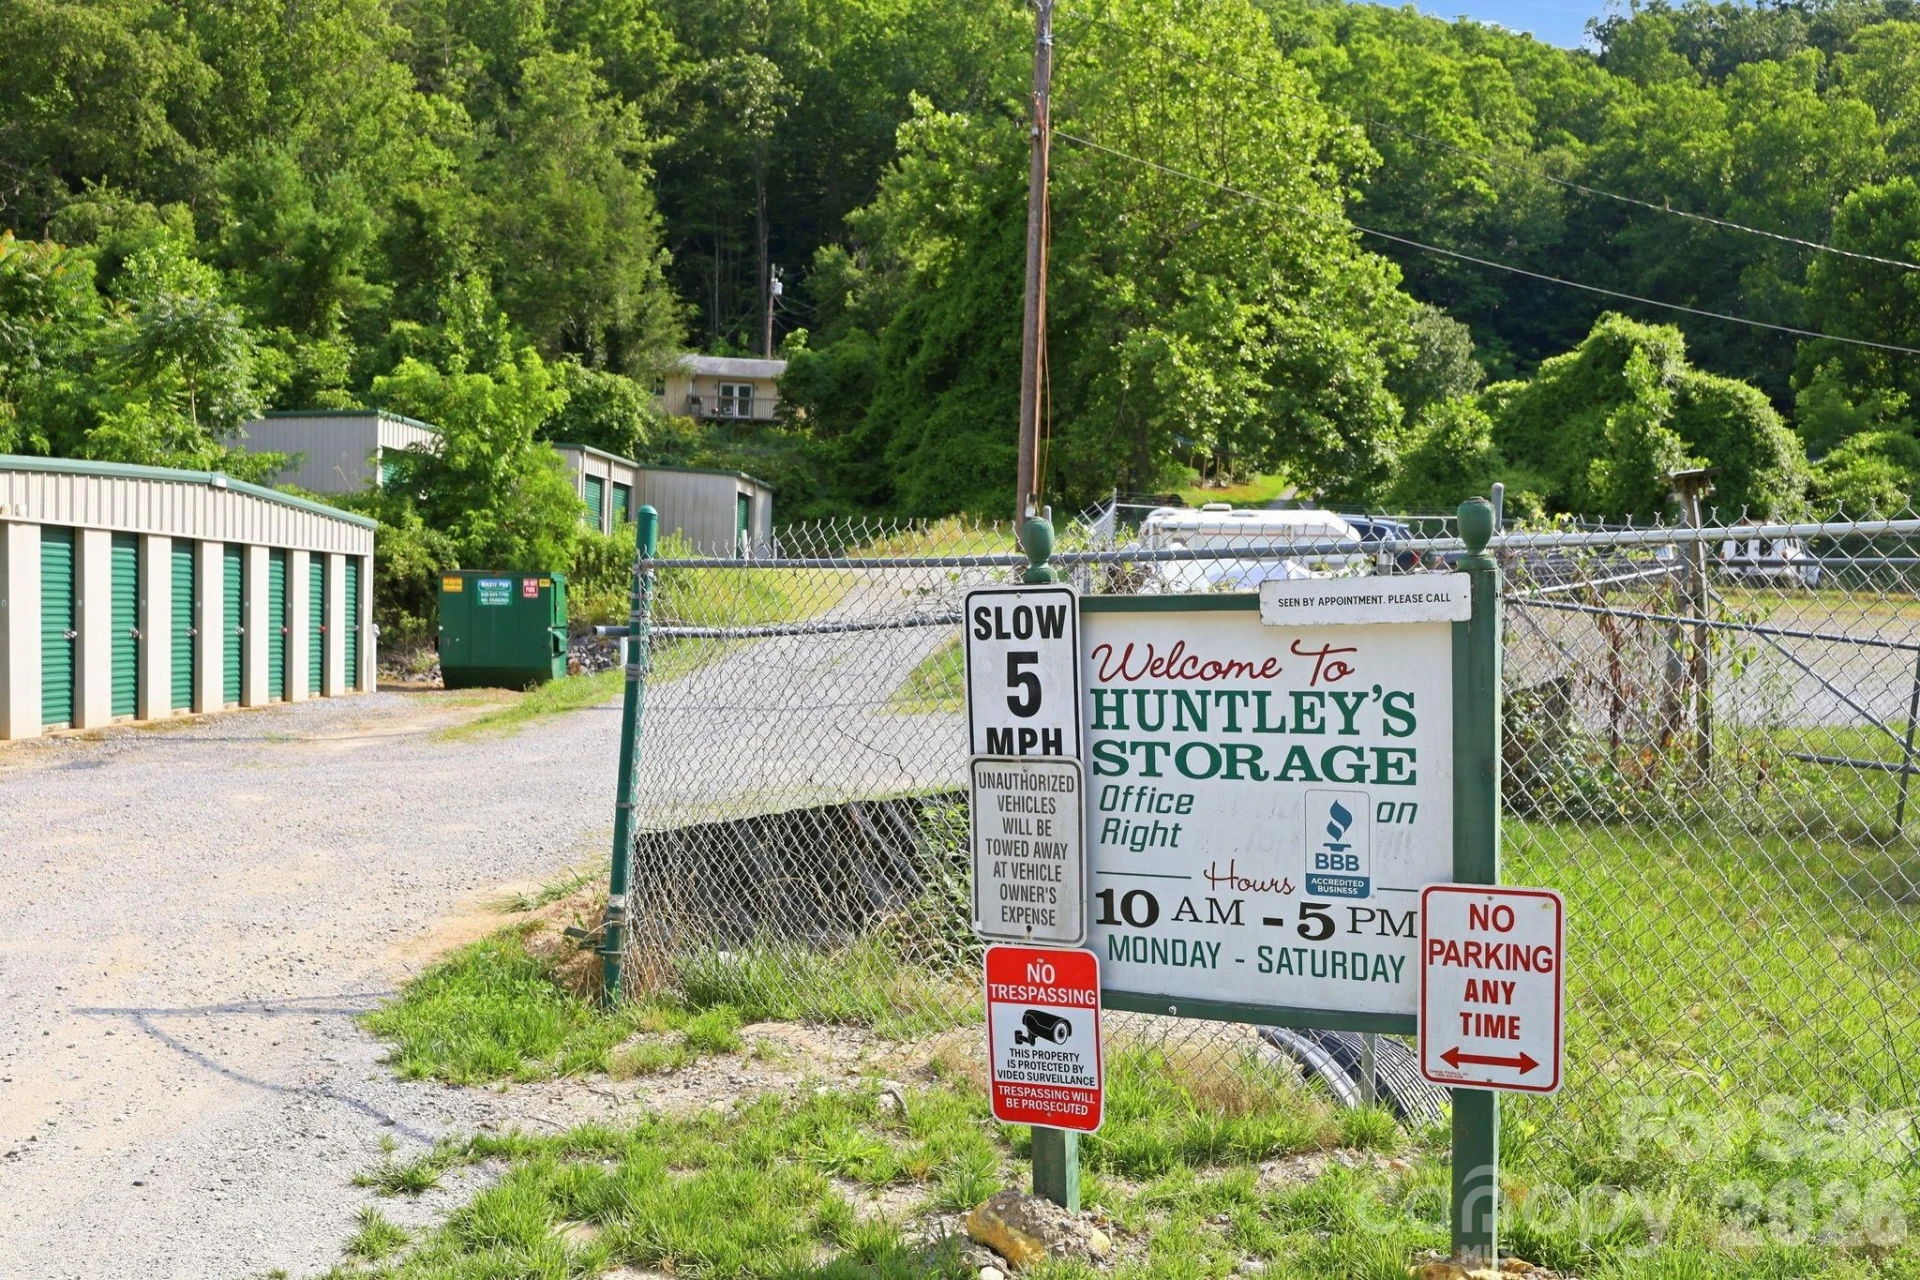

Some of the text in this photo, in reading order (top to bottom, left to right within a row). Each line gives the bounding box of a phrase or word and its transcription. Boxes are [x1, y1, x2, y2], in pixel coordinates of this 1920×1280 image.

[1278, 593, 1451, 608] SEEN BY APPOINTMENT. PLEASE CALL
[973, 604, 1067, 641] SLOW
[1091, 639, 1358, 687] Welcome To
[1006, 651, 1042, 718] 5
[1090, 684, 1417, 738] HUNTLEY'S
[986, 727, 1063, 756] MPH
[1092, 739, 1417, 786] STORAGE
[978, 772, 1075, 793] UNAUTHORIZED
[997, 795, 1056, 815] VEHICLES
[1099, 784, 1418, 825] Office on
[1002, 817, 1052, 837] WILL BE
[1100, 817, 1182, 853] Right
[985, 838, 1068, 860] TOWED AWAY
[993, 861, 1062, 882] AT VEHICLE
[1315, 852, 1360, 872] BBB
[1203, 858, 1296, 895] Hours
[1311, 877, 1365, 888] ACCREDITED
[1000, 883, 1057, 904] OWNER'S
[1317, 885, 1359, 895] BUSINESS
[1001, 906, 1056, 926] EXPENSE
[1095, 888, 1160, 928] 10
[1171, 895, 1246, 926] AM
[1296, 901, 1336, 942] 5
[1346, 906, 1418, 939] PM
[1470, 903, 1515, 933] NO
[1108, 934, 1222, 970] MONDAY
[1257, 945, 1406, 984] SATURDAY
[1428, 938, 1553, 974] PARKING
[1026, 963, 1056, 984] NO
[989, 983, 1096, 1005] TRESPASSING
[1464, 978, 1516, 1005] ANY
[1459, 1012, 1520, 1040] TIME
[1009, 1048, 1080, 1062] THIS PROPERTY
[1007, 1059, 1084, 1074] IS PROTECTED BY
[997, 1069, 1096, 1087] VIDEO SURVEILLANCE
[998, 1085, 1096, 1104] TRESPASSING WILL
[1006, 1097, 1088, 1116] BE PROSECUTED
